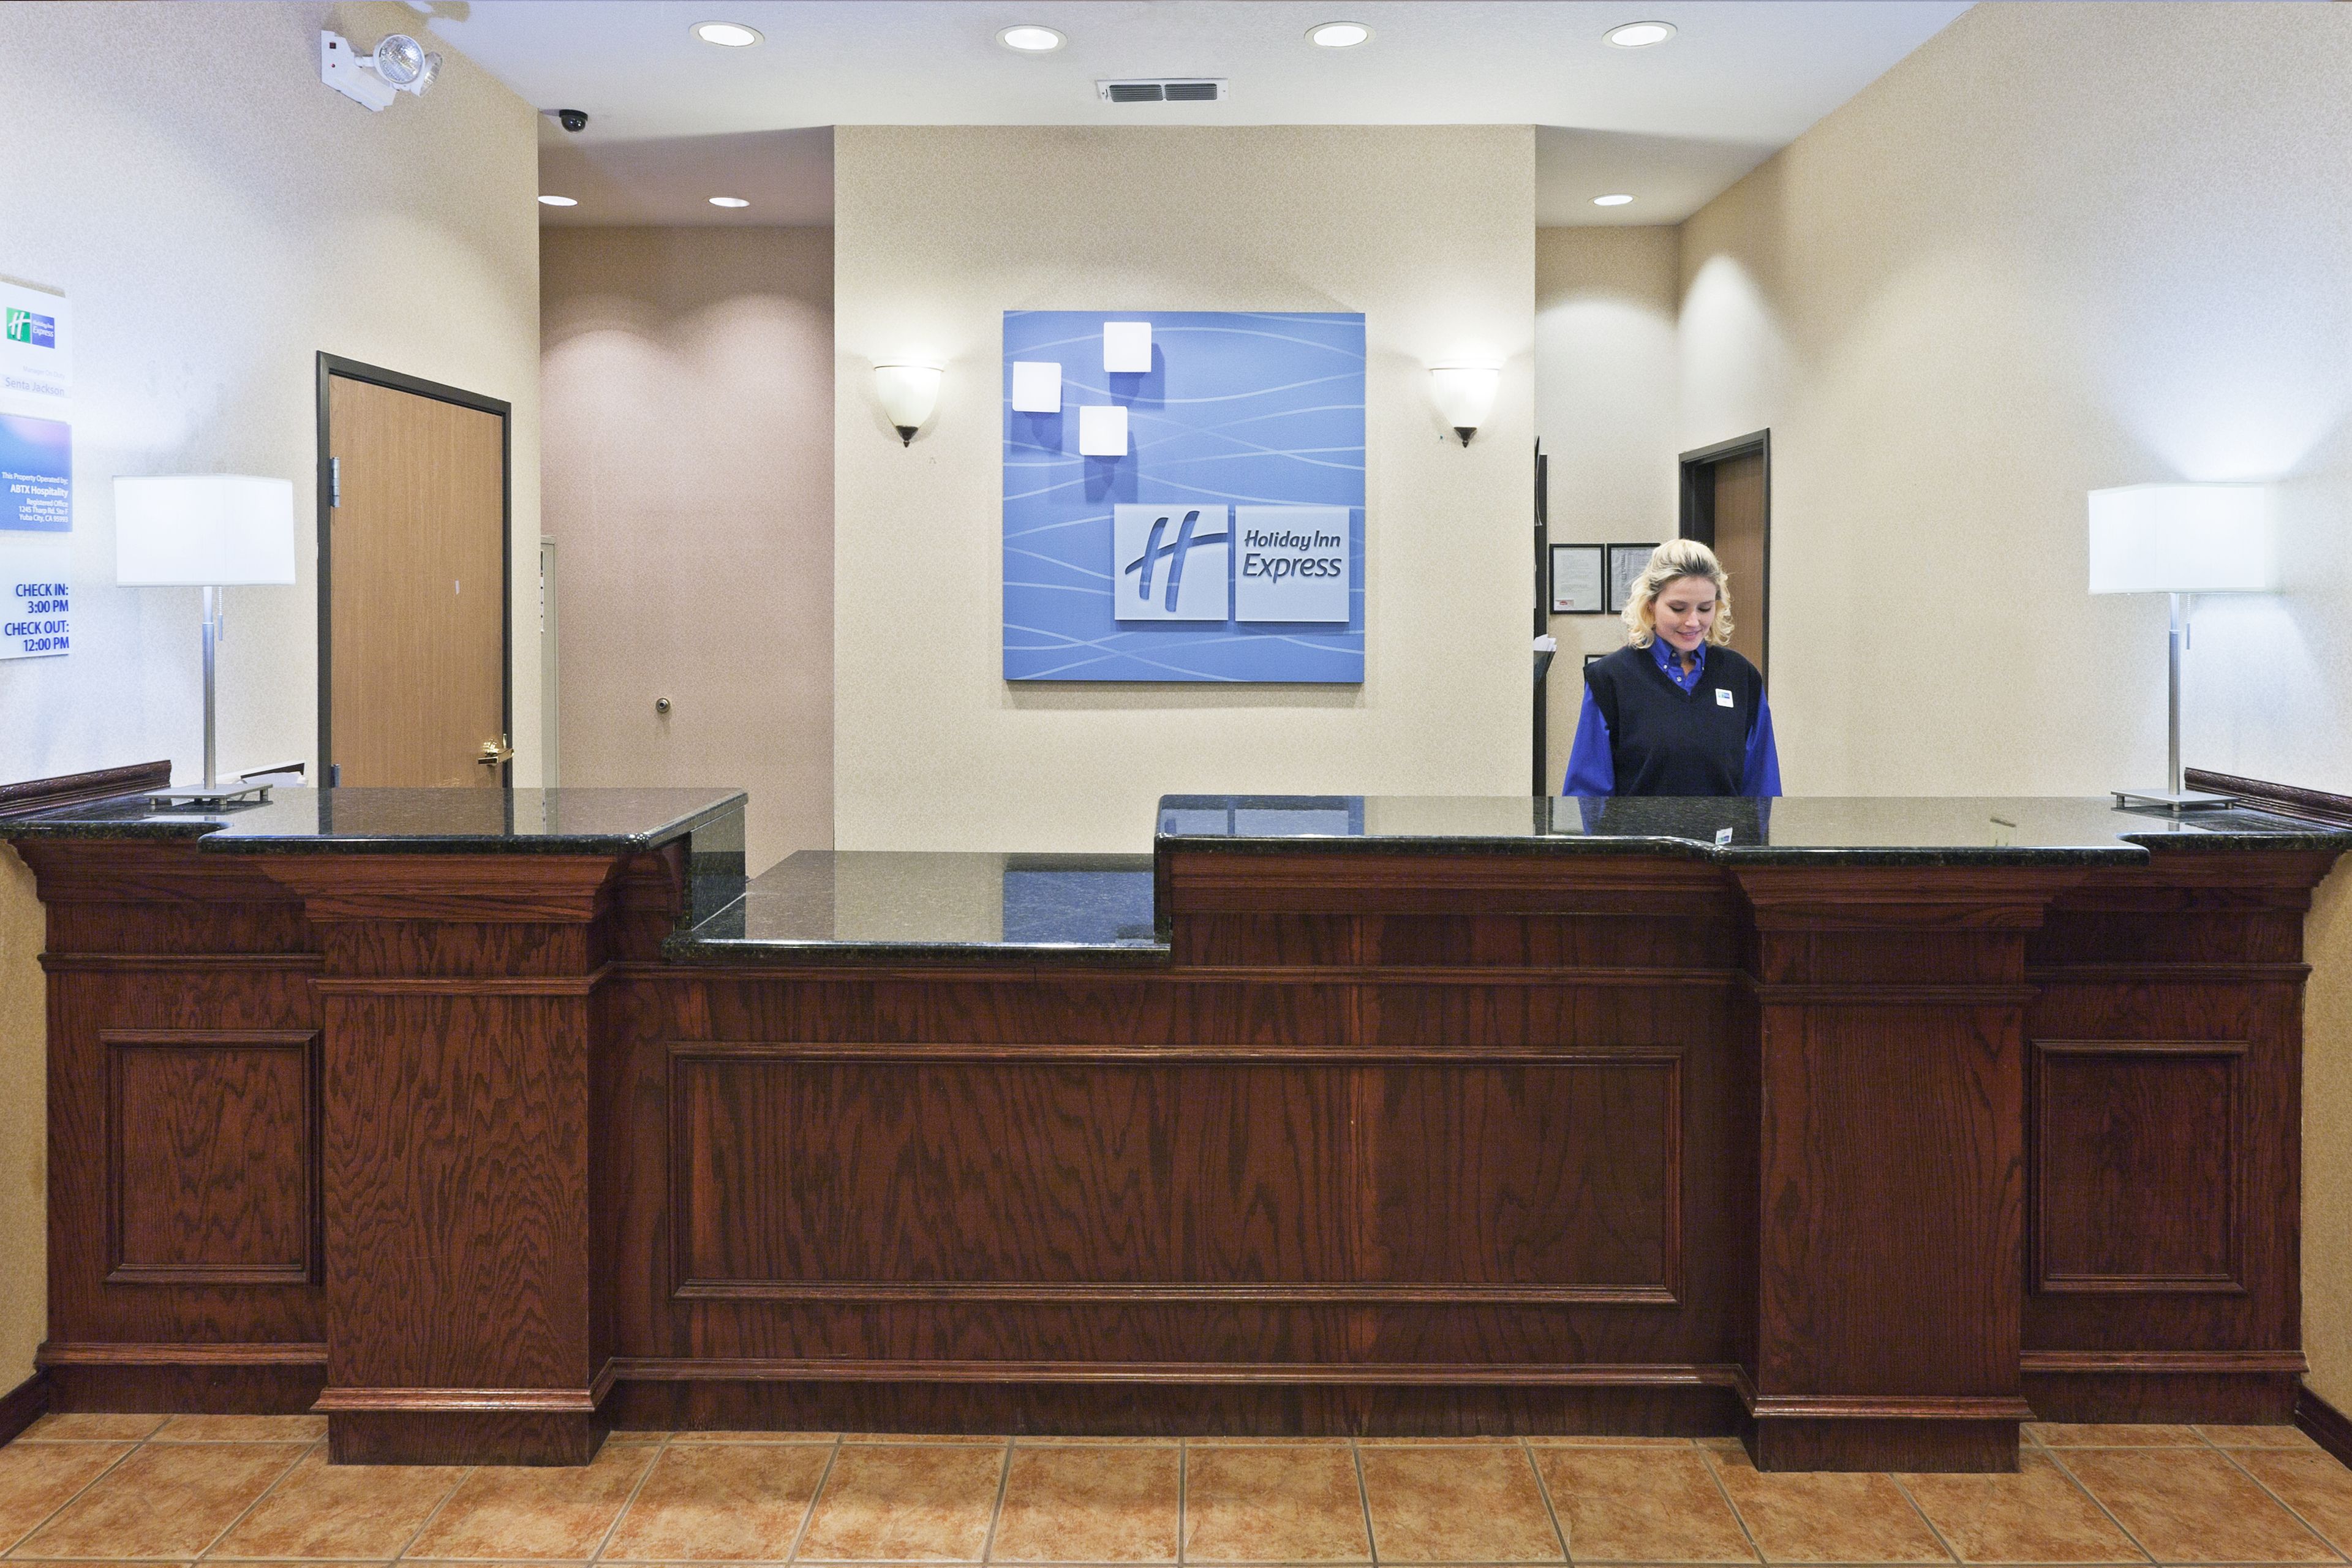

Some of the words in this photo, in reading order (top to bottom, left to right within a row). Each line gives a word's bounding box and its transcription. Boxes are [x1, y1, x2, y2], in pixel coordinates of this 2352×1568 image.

[32, 326, 54, 337] Express
[6, 377, 30, 390] Senta
[32, 382, 64, 397] Jackson
[13, 473, 36, 483] Property
[10, 484, 31, 494] ABTX
[31, 486, 69, 499] Hospitality
[26, 498, 53, 508] Registered
[1244, 530, 1312, 551] Holiday
[1313, 530, 1341, 548] Inn
[1242, 553, 1342, 584] Express
[15, 584, 53, 597] CHECK
[54, 583, 69, 596] IN:
[28, 600, 50, 613] 3:00
[53, 600, 69, 612] PM
[4, 622, 42, 636] CHECK
[44, 620, 69, 633] OUT:
[23, 638, 51, 651] 12:00
[53, 636, 69, 649] PM
